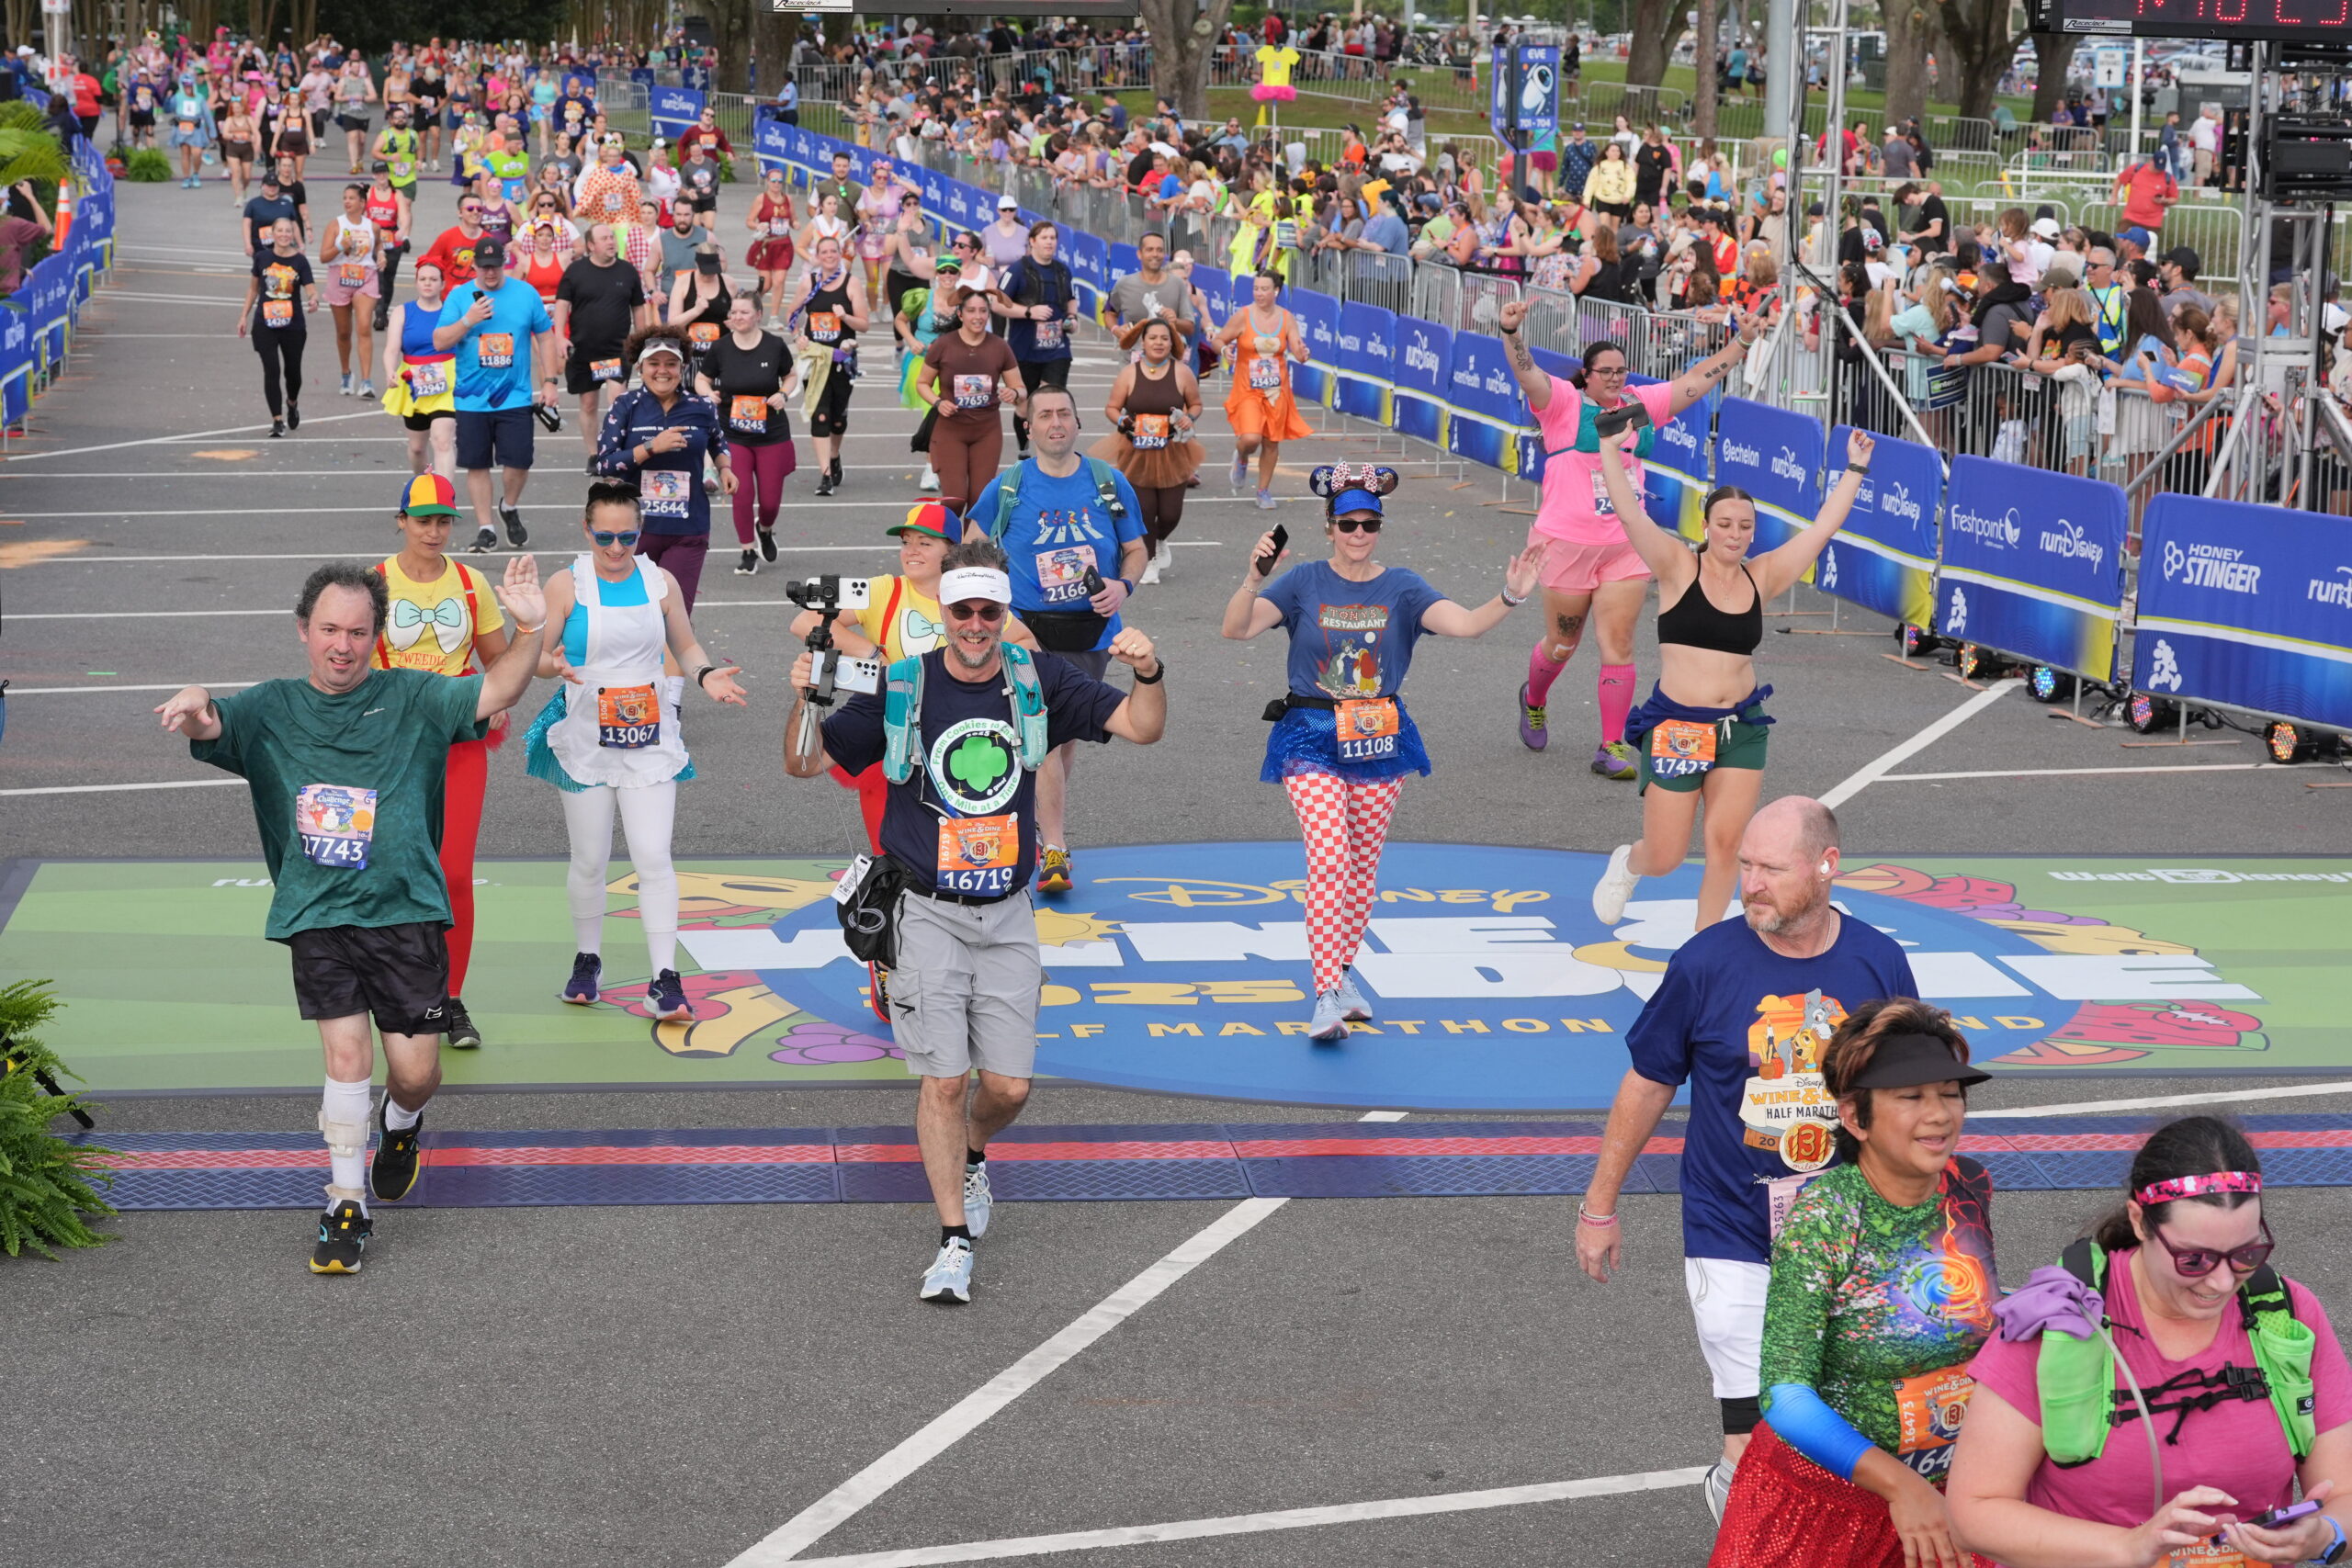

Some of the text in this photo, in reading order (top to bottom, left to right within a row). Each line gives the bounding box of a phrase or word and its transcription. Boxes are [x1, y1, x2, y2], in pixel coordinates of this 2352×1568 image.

[2065, 19, 2106, 28] Raceclock
[1527, 48, 1546, 60] EVE
[1520, 118, 1532, 128] 701
[1536, 118, 1552, 128] 704
[341, 277, 364, 287] 15919
[481, 355, 512, 366] 11886
[594, 366, 620, 379] 16079
[417, 382, 446, 396] 22947
[957, 394, 989, 406] 27659
[732, 420, 764, 431] 16245
[1135, 435, 1165, 447] 17524
[1663, 417, 1697, 458] runDisney
[1731, 442, 1806, 493] echelon runDisney
[644, 500, 685, 515] 25644
[1882, 481, 1921, 531] runDisney
[1951, 504, 2103, 575] freshpoint runDisney
[2188, 543, 2244, 562] HONEY
[2182, 557, 2261, 594] STINGER
[1047, 581, 1088, 603] 2166
[1323, 616, 1386, 629] RESTAURANT
[397, 652, 447, 666] TWEEDLE
[605, 724, 656, 744] 13067
[933, 739, 947, 765] From
[946, 720, 987, 739] Cookies
[1343, 736, 1394, 758] 11108
[1655, 757, 1709, 774] 17423
[317, 795, 353, 806] Challenge
[937, 781, 954, 800] One
[955, 800, 978, 812] Mile
[980, 803, 990, 812] at
[999, 776, 1018, 800] Time
[957, 827, 977, 835] WINE
[302, 834, 364, 862] 27743
[941, 833, 950, 863] 16719
[944, 867, 1013, 891] 16719
[2047, 871, 2157, 882] Walt
[1092, 877, 1551, 914] Diney
[1148, 1018, 1615, 1038] MARATHON
[1793, 1076, 1825, 1089] Disney
[1748, 1089, 1801, 1106] WINE
[1802, 1088, 1822, 1105] &
[1767, 1105, 1838, 1119] HALF MARATH
[1792, 1162, 1820, 1171] miles
[1923, 1382, 1950, 1397] WINE
[1950, 1379, 1960, 1391] &
[1958, 1376, 1974, 1385] DIN
[1902, 1400, 1916, 1444] 16473
[1904, 1444, 1956, 1474] 164
[2169, 1546, 2206, 1558] WINE
[2207, 1545, 2221, 1557] &
